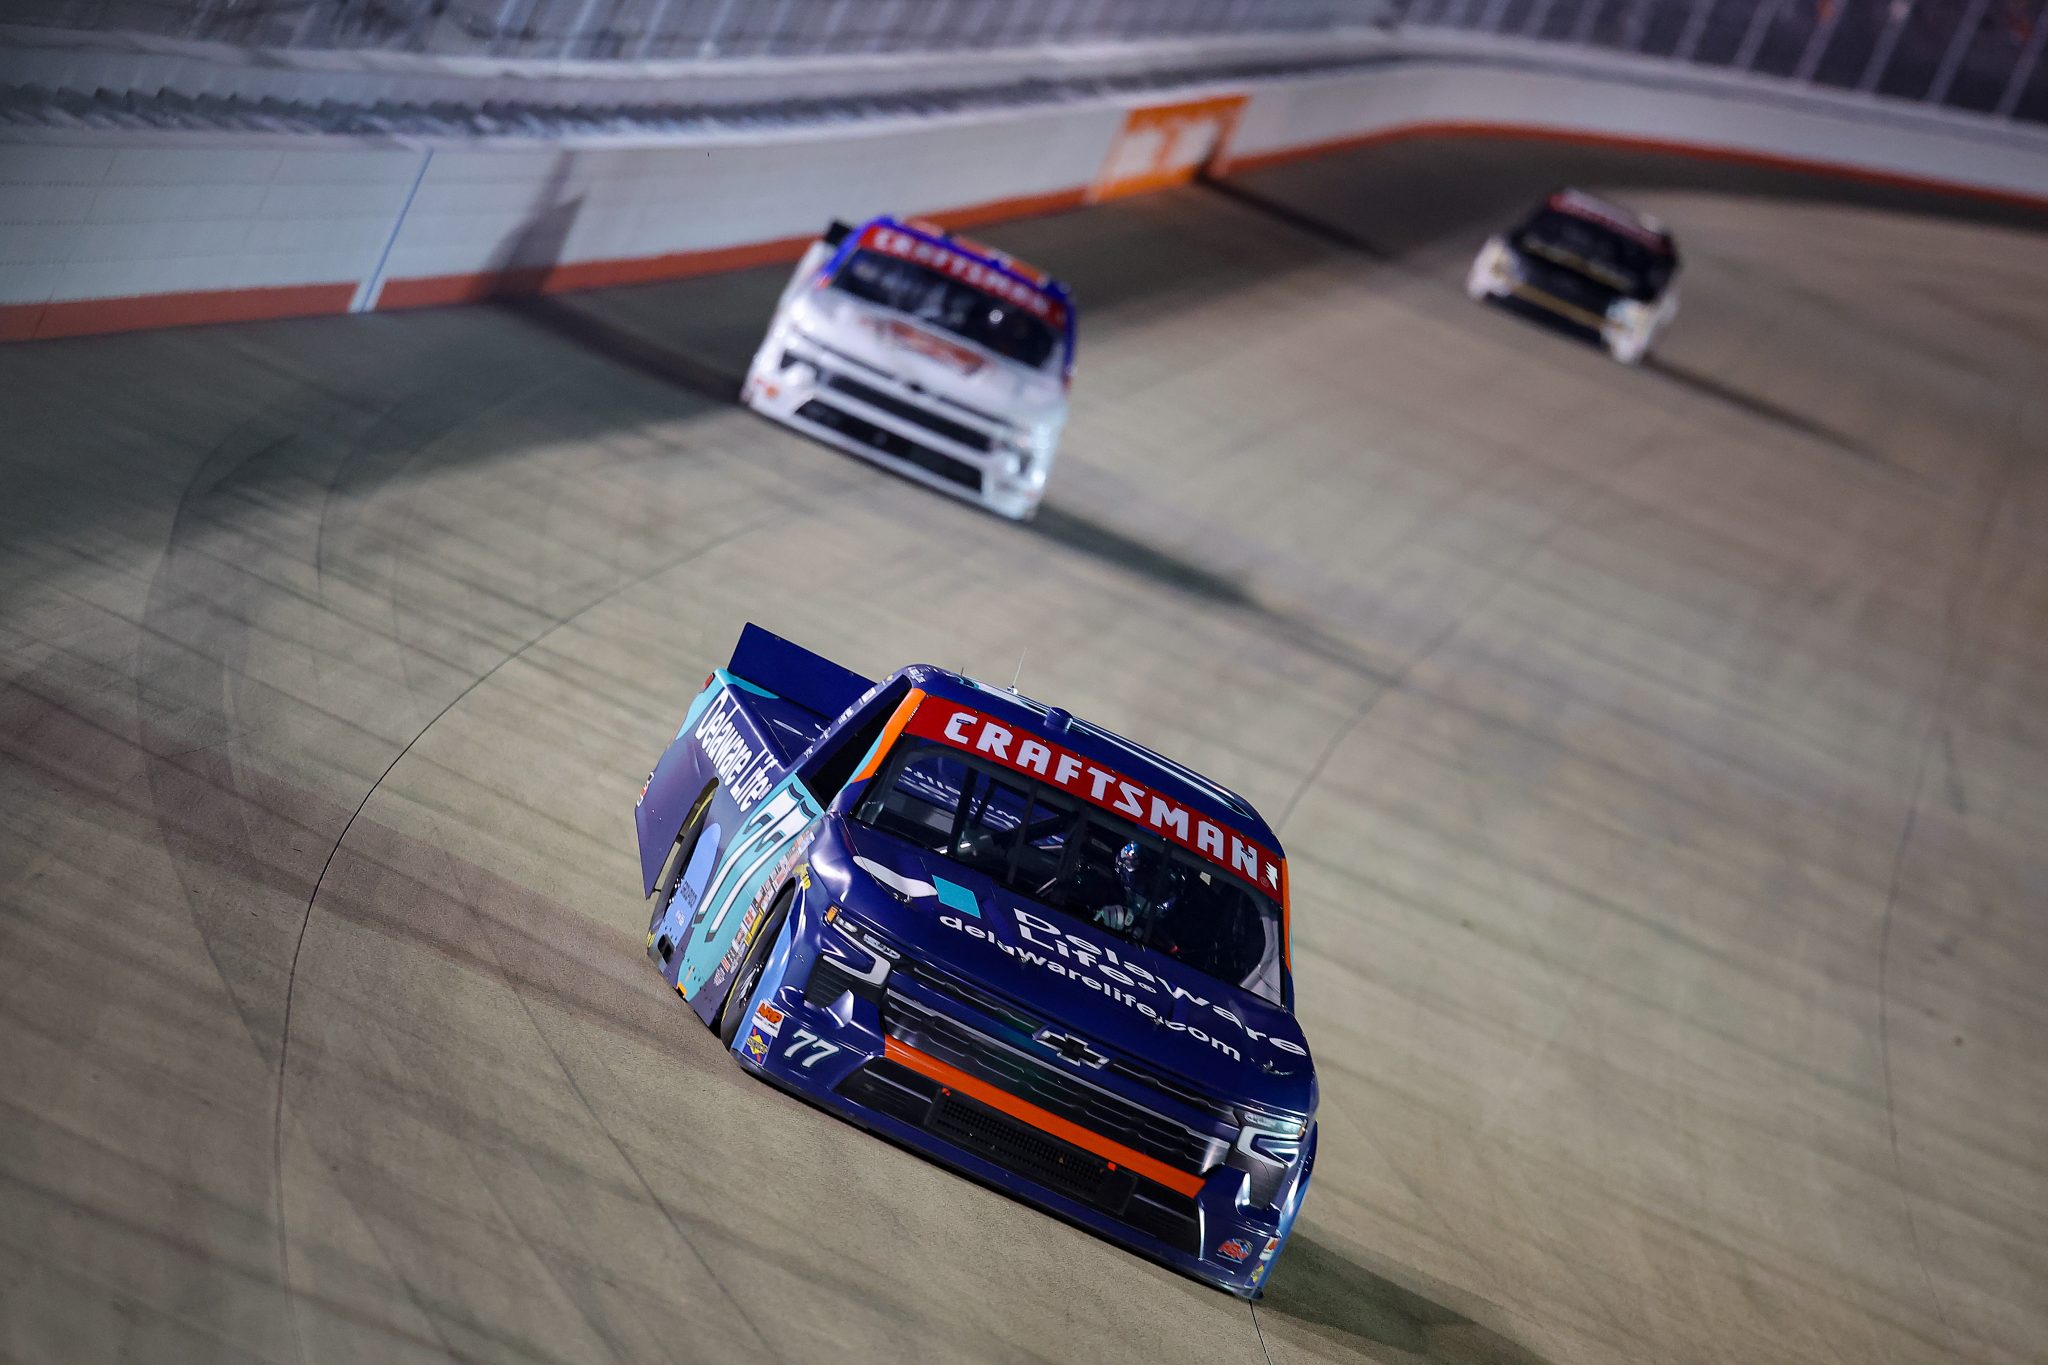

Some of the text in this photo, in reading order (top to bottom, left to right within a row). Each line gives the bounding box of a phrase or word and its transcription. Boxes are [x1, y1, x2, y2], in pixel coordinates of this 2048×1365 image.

[695, 688, 753, 787] Delaware
[729, 748, 779, 813] Life
[943, 711, 1259, 881] CRAFTSMAN
[692, 782, 817, 943] 77
[939, 914, 1241, 1063] delawarelife.com
[1013, 908, 1307, 1057] Delaware
[1017, 922, 1136, 988] Life
[783, 1028, 840, 1068] 77
